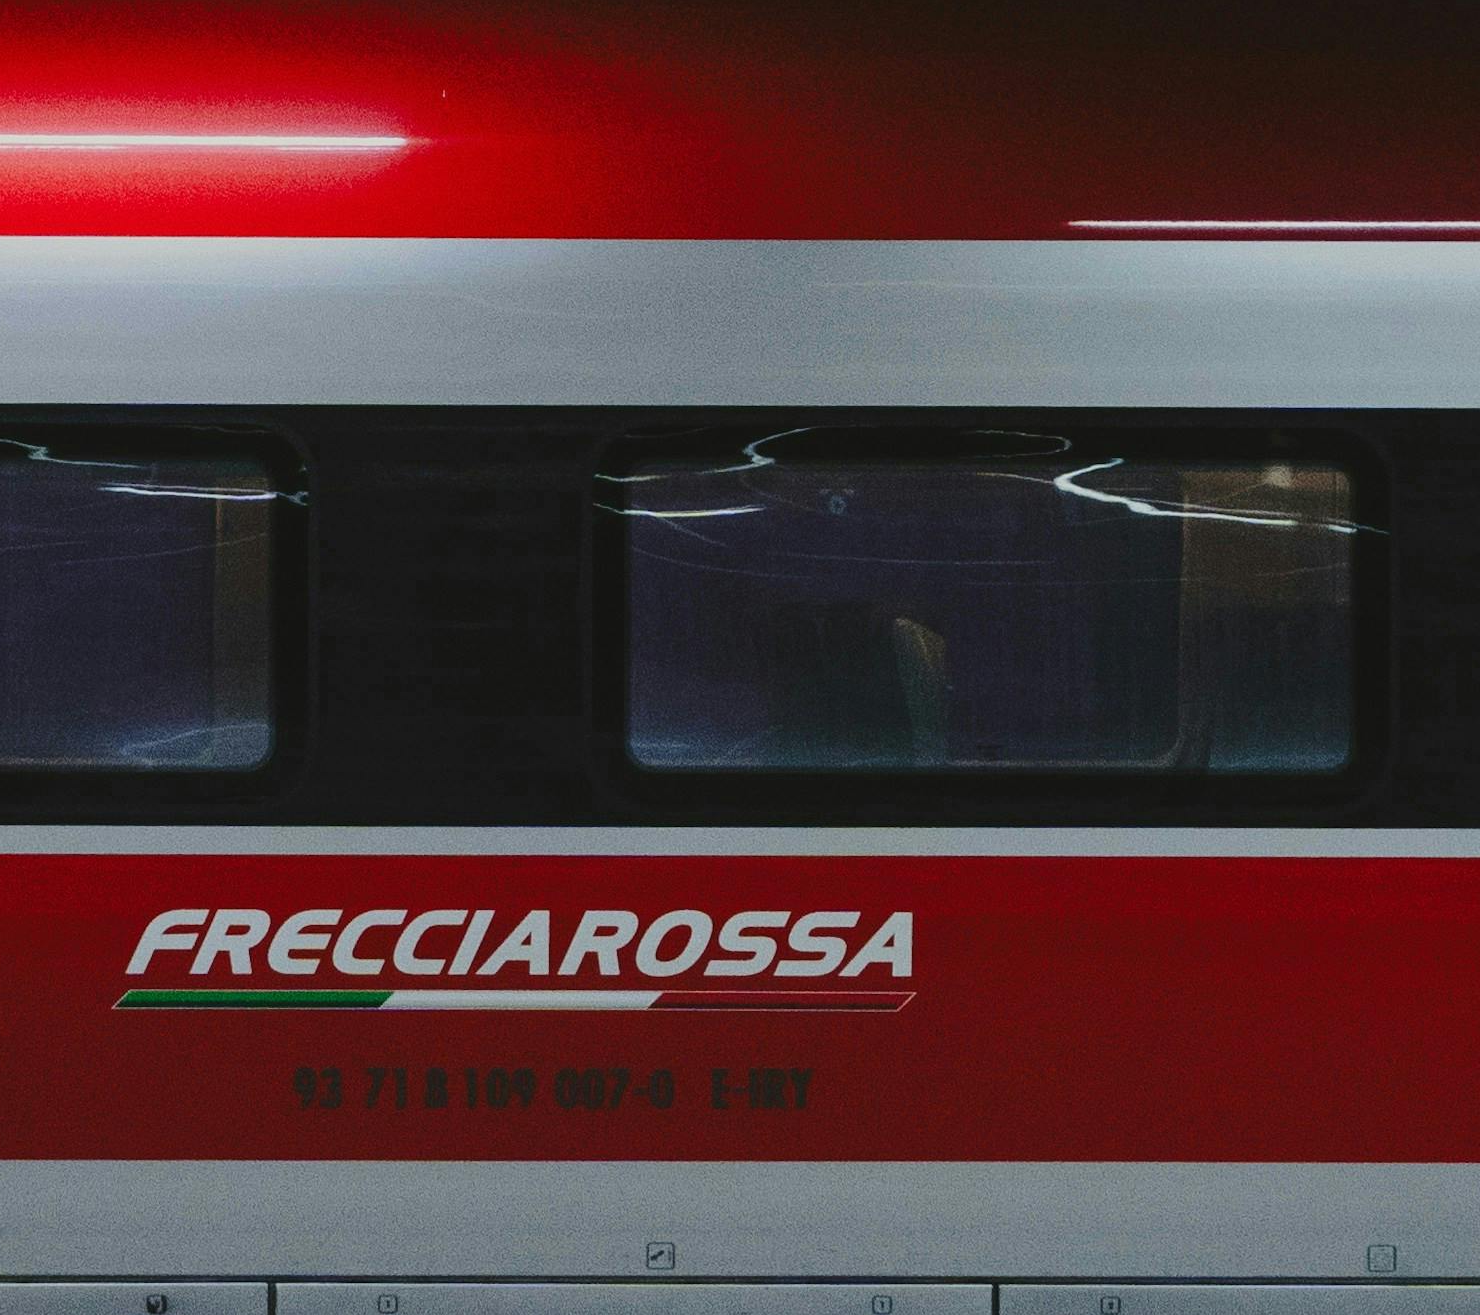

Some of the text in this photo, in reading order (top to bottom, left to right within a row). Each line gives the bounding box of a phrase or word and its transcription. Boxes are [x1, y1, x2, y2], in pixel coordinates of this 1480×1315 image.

[126, 908, 915, 977] FRECCIAROSSA
[294, 1067, 344, 1111] 93
[365, 1068, 408, 1111] 71
[465, 1067, 538, 1111] 109
[553, 1067, 676, 1112] 007-0
